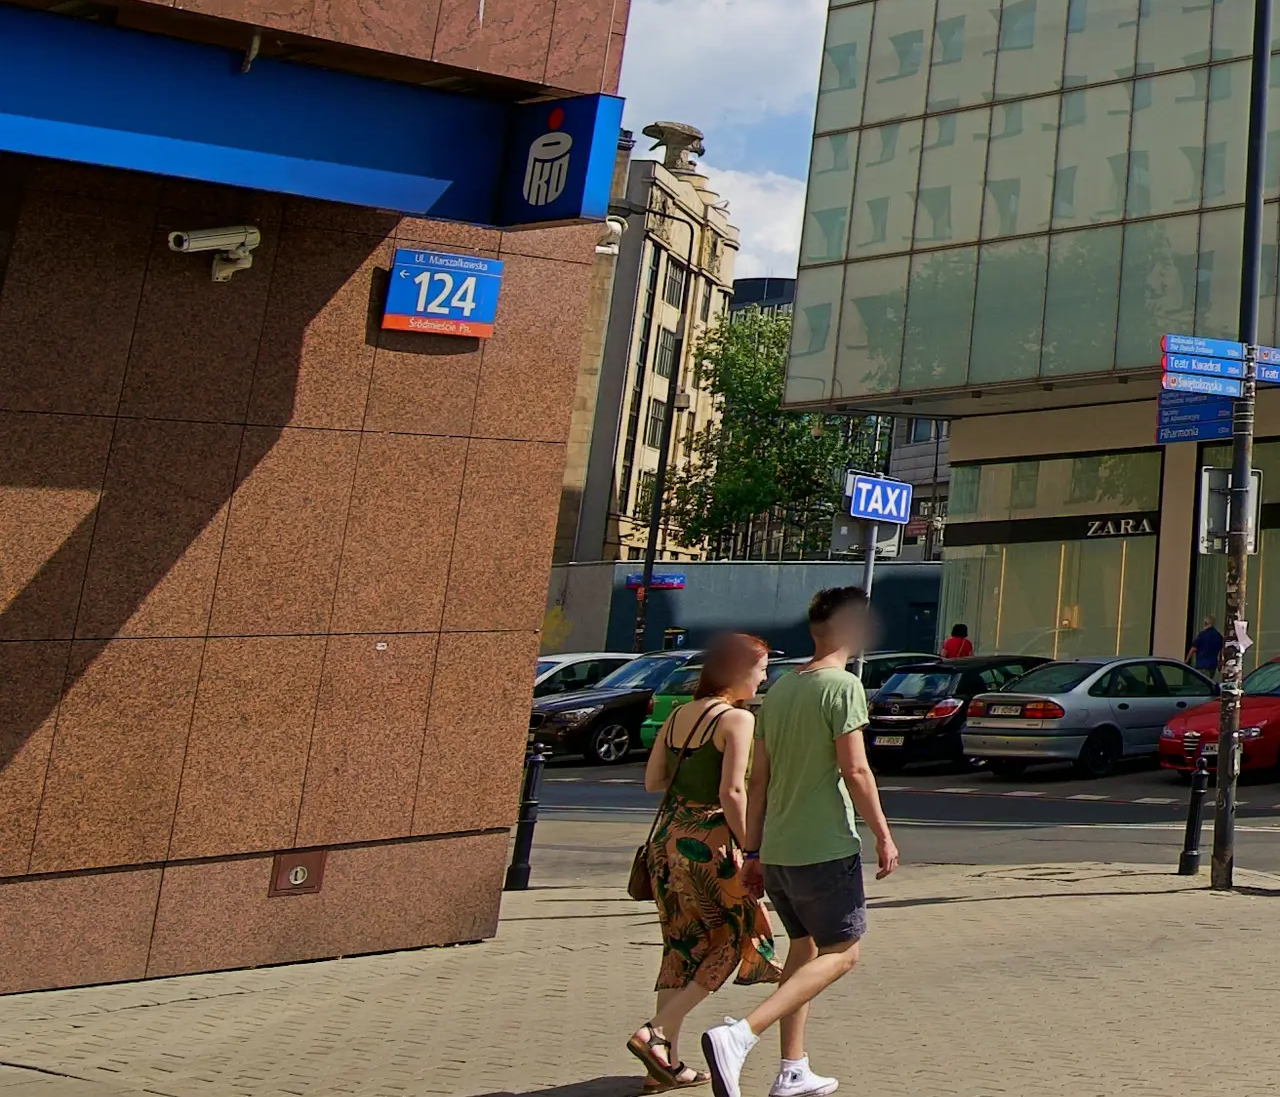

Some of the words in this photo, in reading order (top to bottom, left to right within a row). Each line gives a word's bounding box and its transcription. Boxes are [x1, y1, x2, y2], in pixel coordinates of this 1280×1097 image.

[429, 255, 488, 271] Marszałkowska
[414, 271, 477, 317] 124
[1170, 357, 1189, 369] Teatr
[1191, 358, 1221, 373] Kwadrat
[1261, 367, 1279, 379] Teatr
[1160, 426, 1199, 439] Filharmonia
[857, 481, 908, 518] TAXI
[1086, 518, 1154, 536] ZARA
